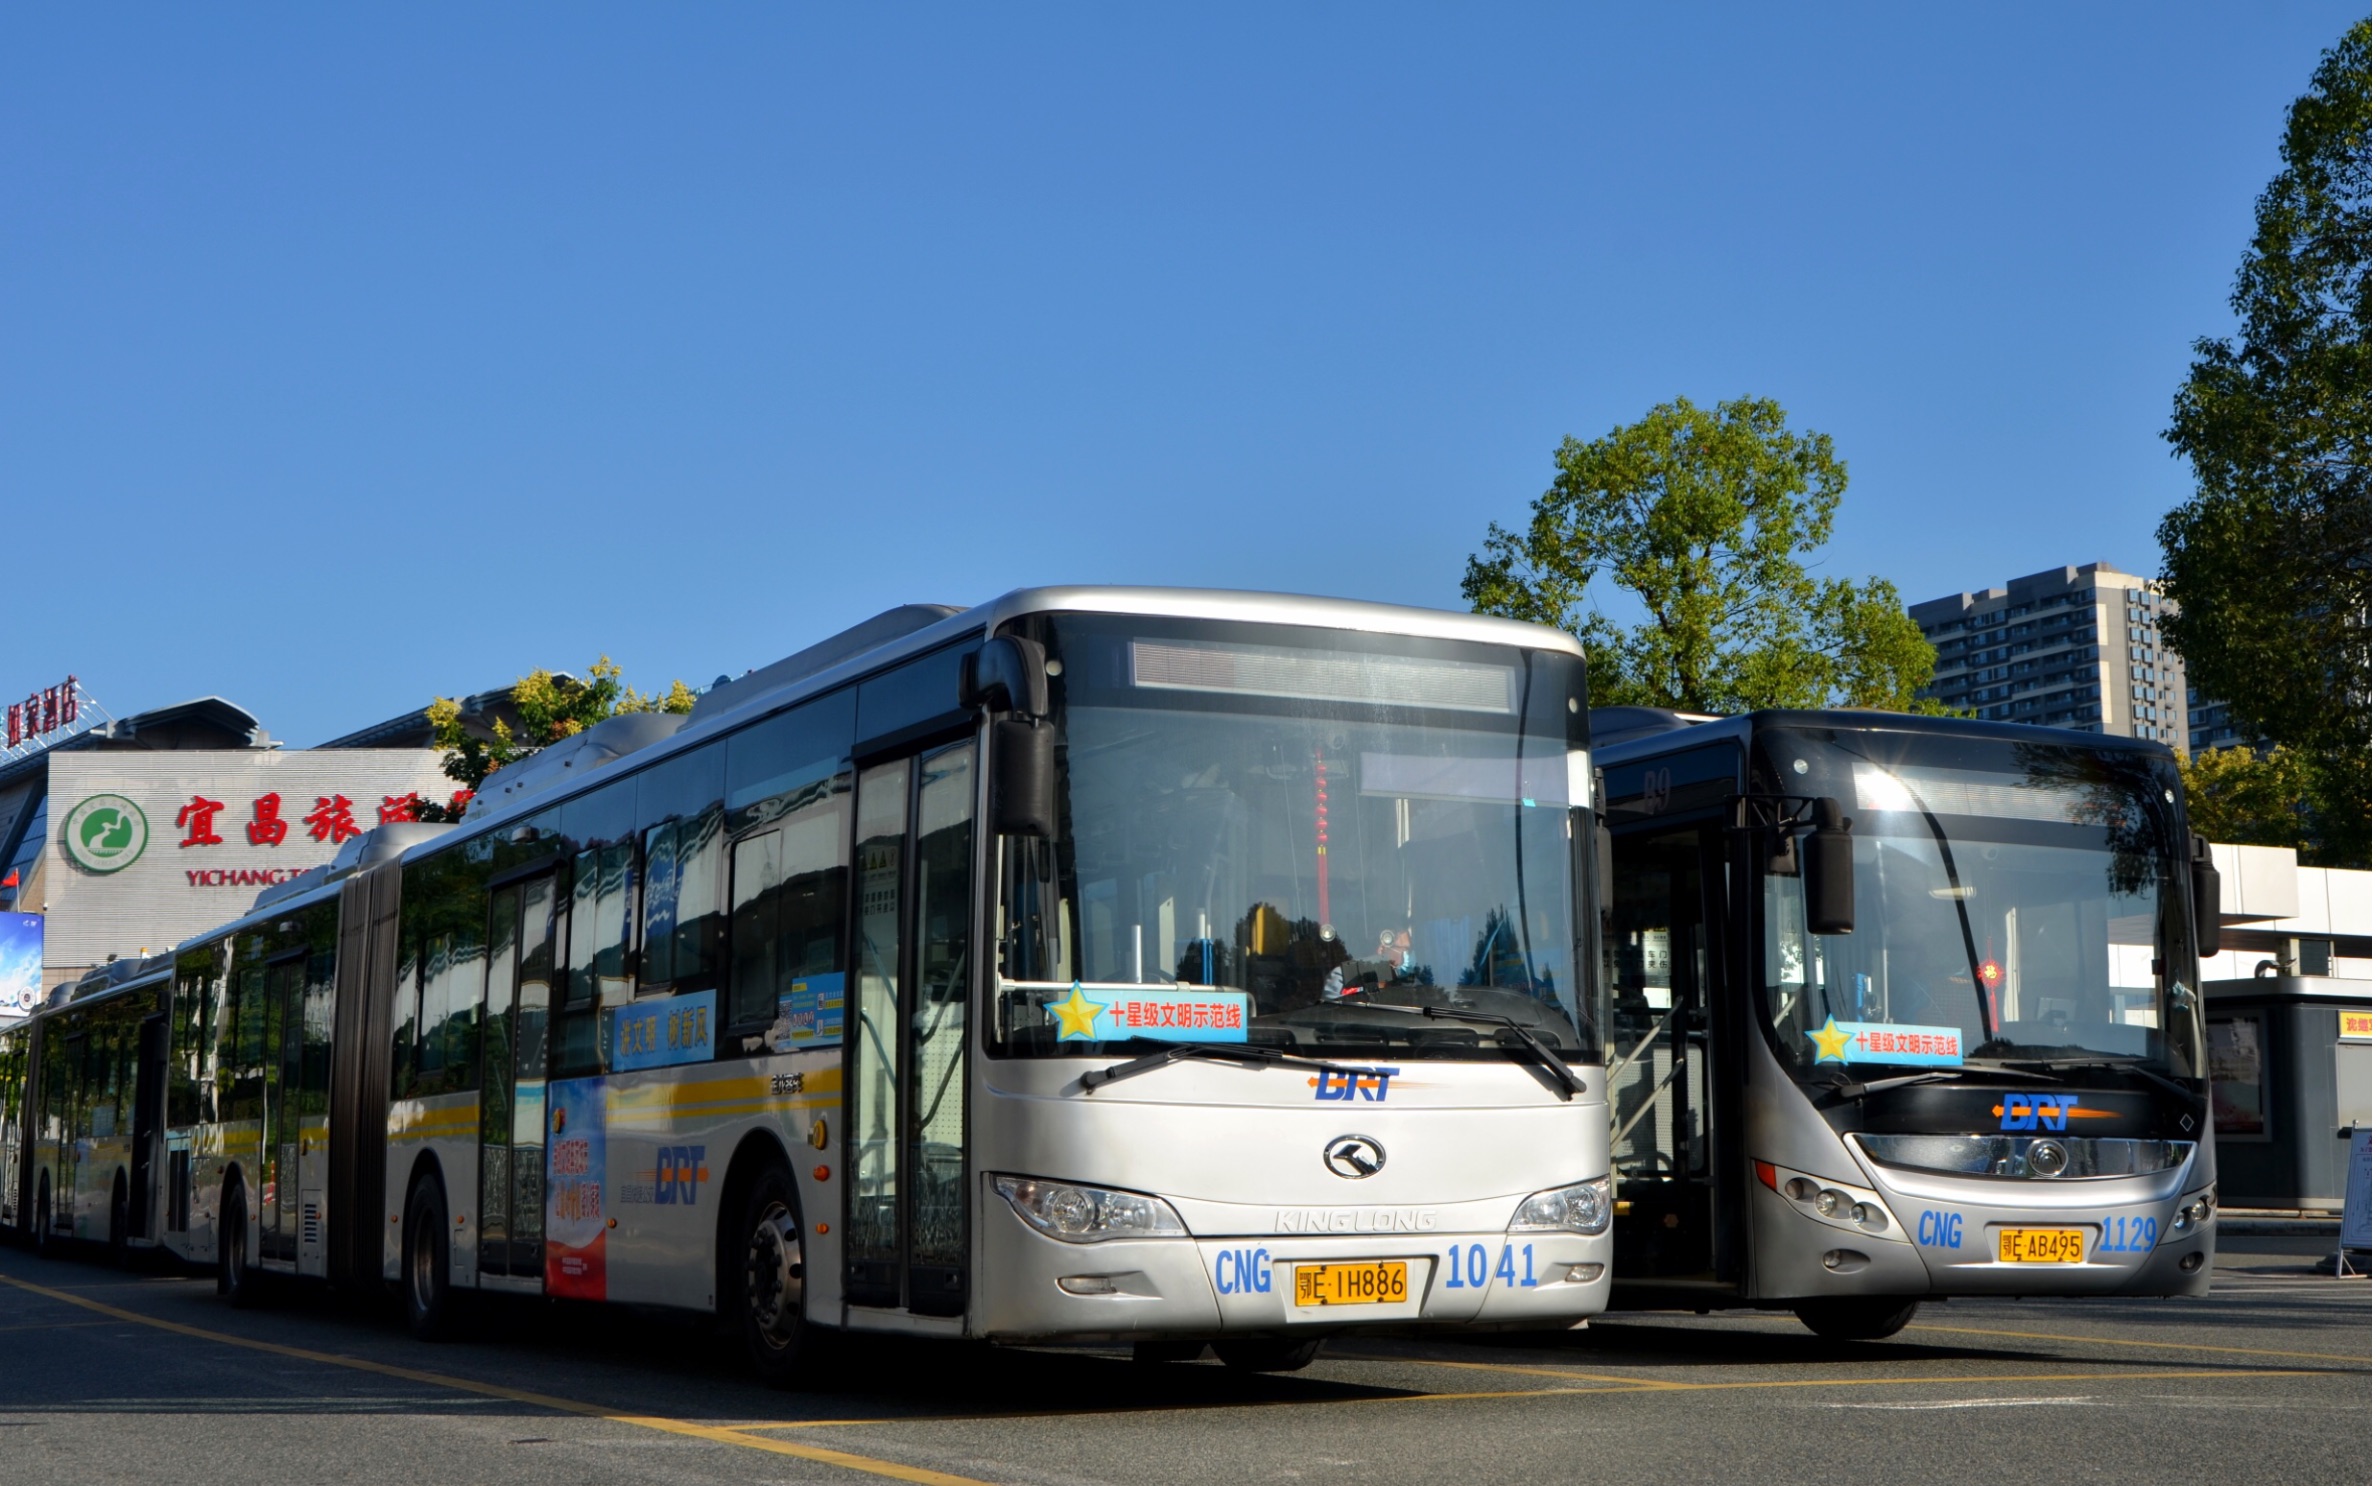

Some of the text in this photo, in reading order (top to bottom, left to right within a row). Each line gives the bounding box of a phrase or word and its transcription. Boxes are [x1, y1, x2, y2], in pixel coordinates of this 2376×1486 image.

[1644, 767, 1671, 815] B9
[177, 790, 475, 847] 宜昌旅游
[187, 869, 285, 887] YICHANG
[1109, 1001, 1242, 1030] 十星级文明示范线
[1856, 1031, 1960, 1057] 十星级文明示范线
[1315, 1066, 1400, 1102] BRT
[2000, 1094, 2079, 1131] BRT
[655, 1145, 706, 1205] BRT
[1918, 1210, 1963, 1249] CNG
[2100, 1216, 2157, 1253] 1129
[1215, 1248, 1272, 1294] CNG
[1446, 1243, 1538, 1289] 1041
